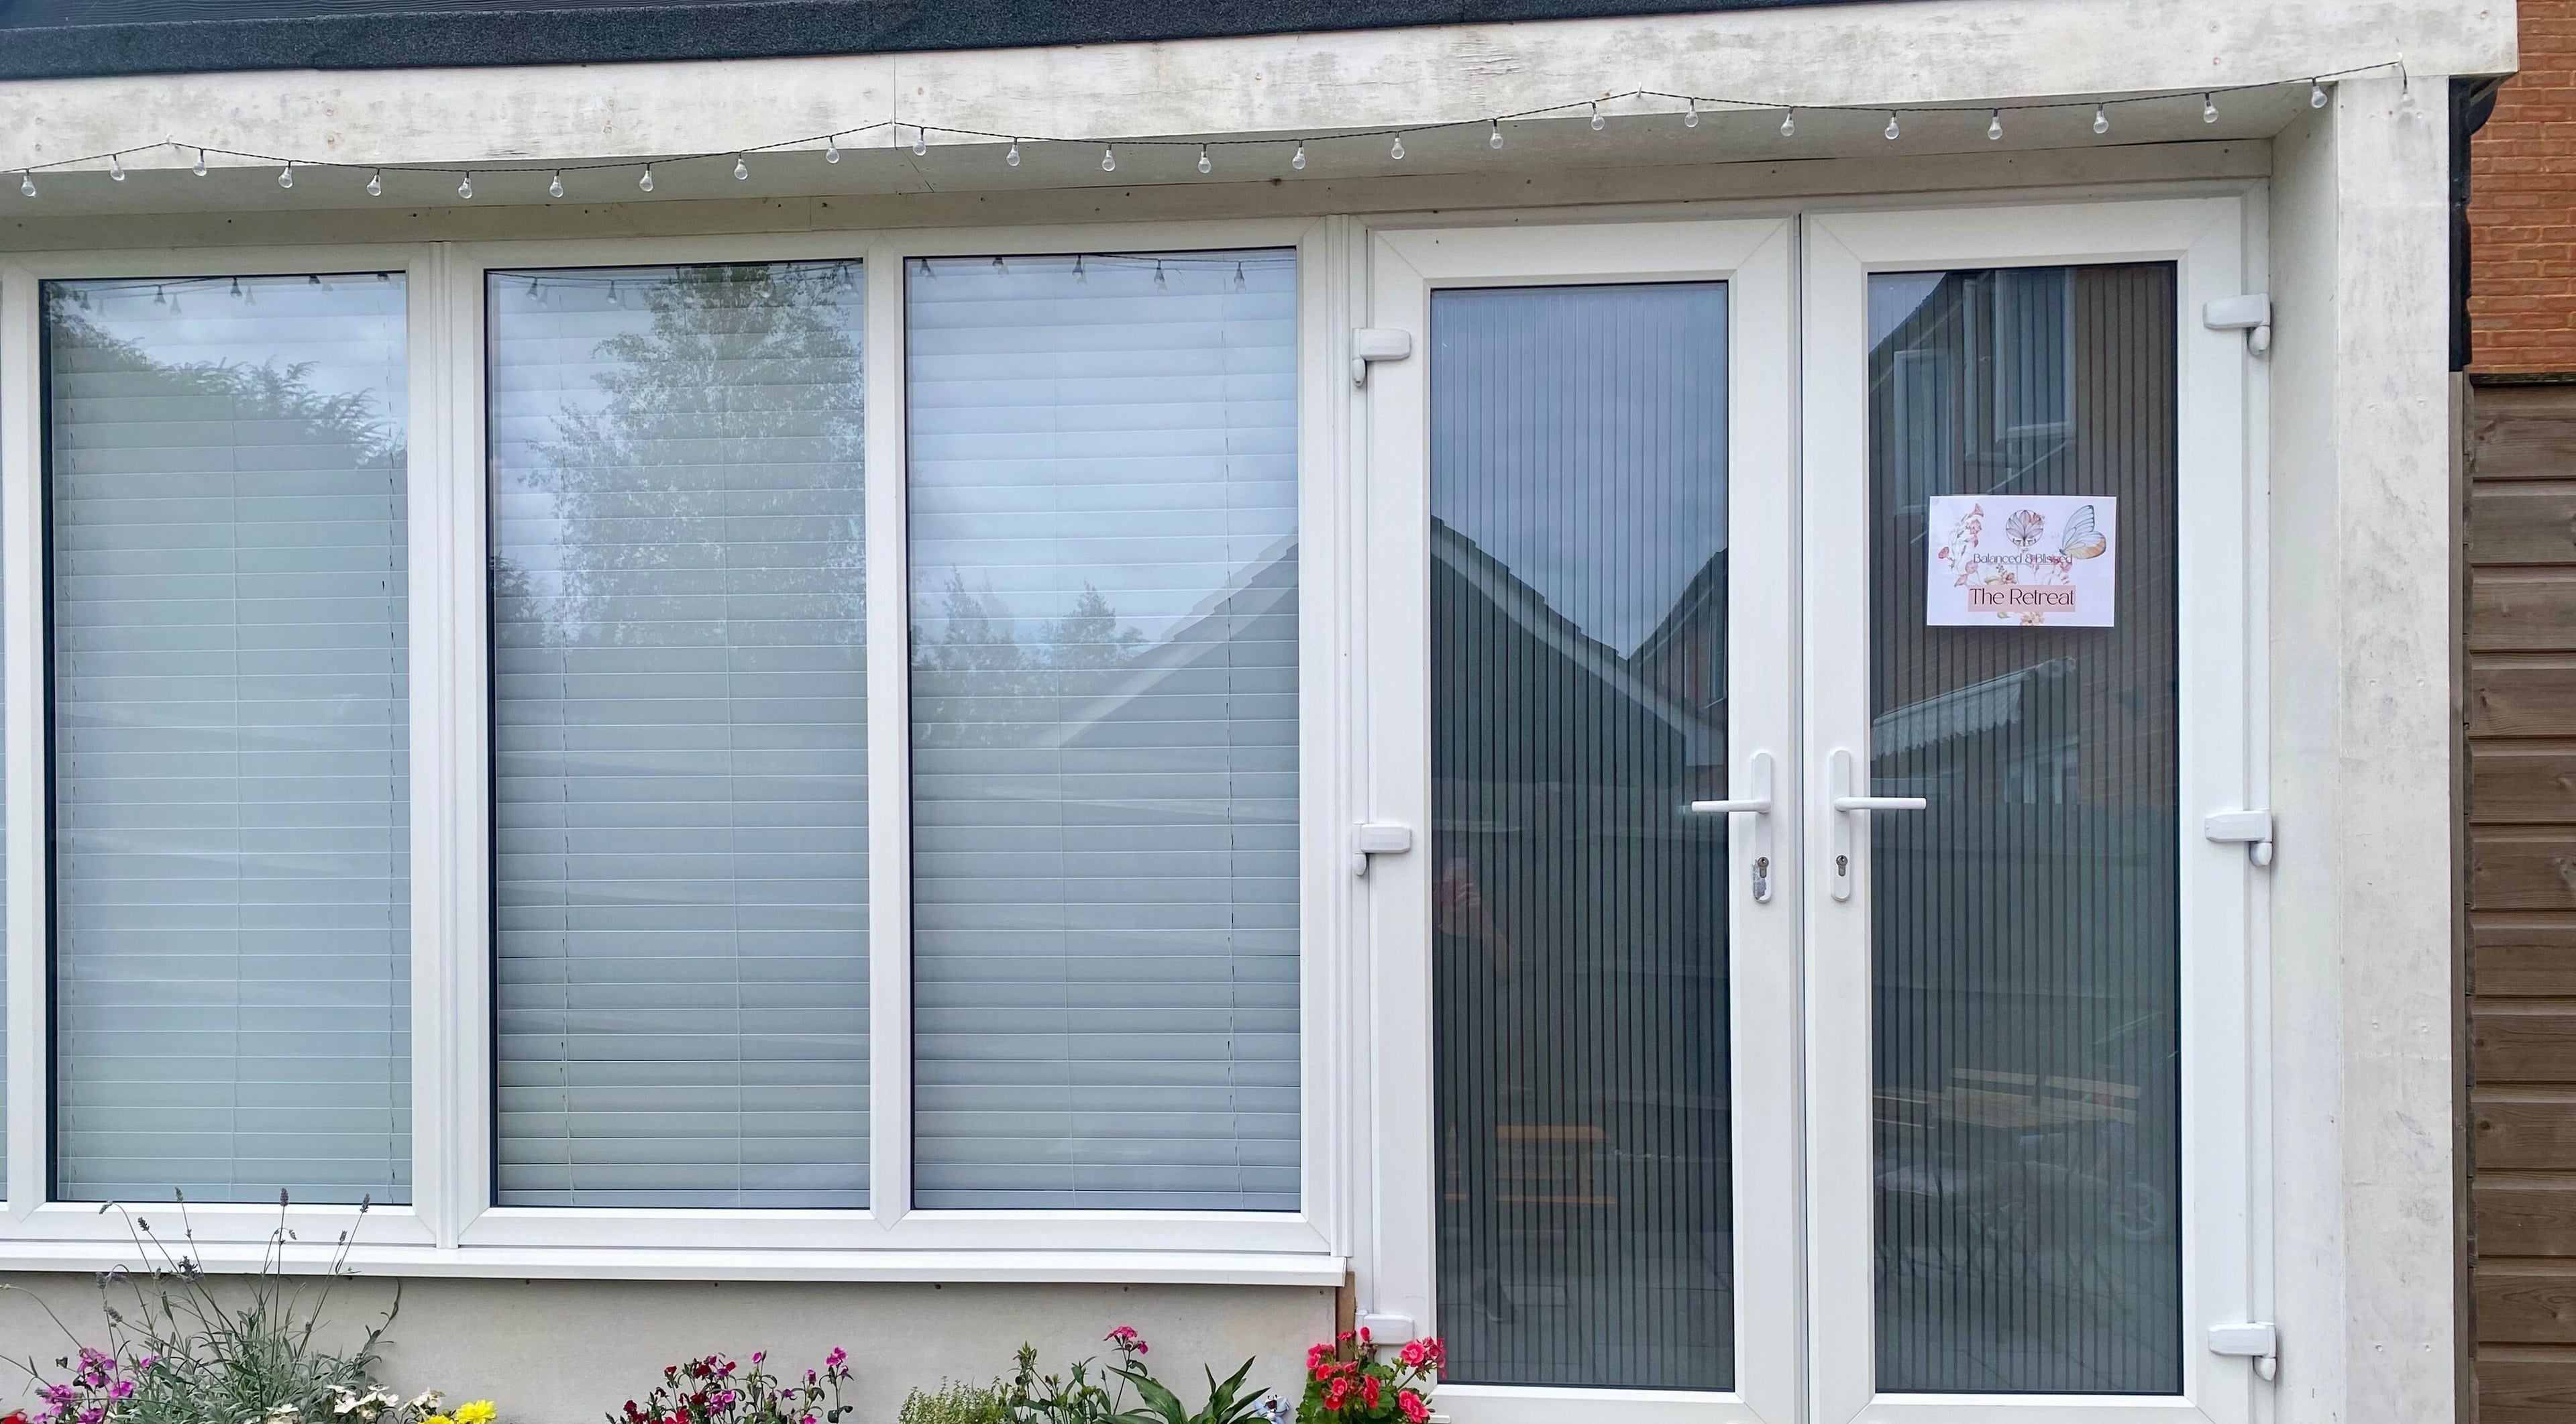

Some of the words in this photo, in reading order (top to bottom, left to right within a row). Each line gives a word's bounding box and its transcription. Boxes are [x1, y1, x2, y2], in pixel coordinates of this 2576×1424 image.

[1973, 553, 2022, 563] Balanced
[2025, 553, 2033, 563] &
[2035, 553, 2073, 563] Blissed
[1970, 588, 2004, 605] The
[2010, 588, 2074, 605] Retreat
